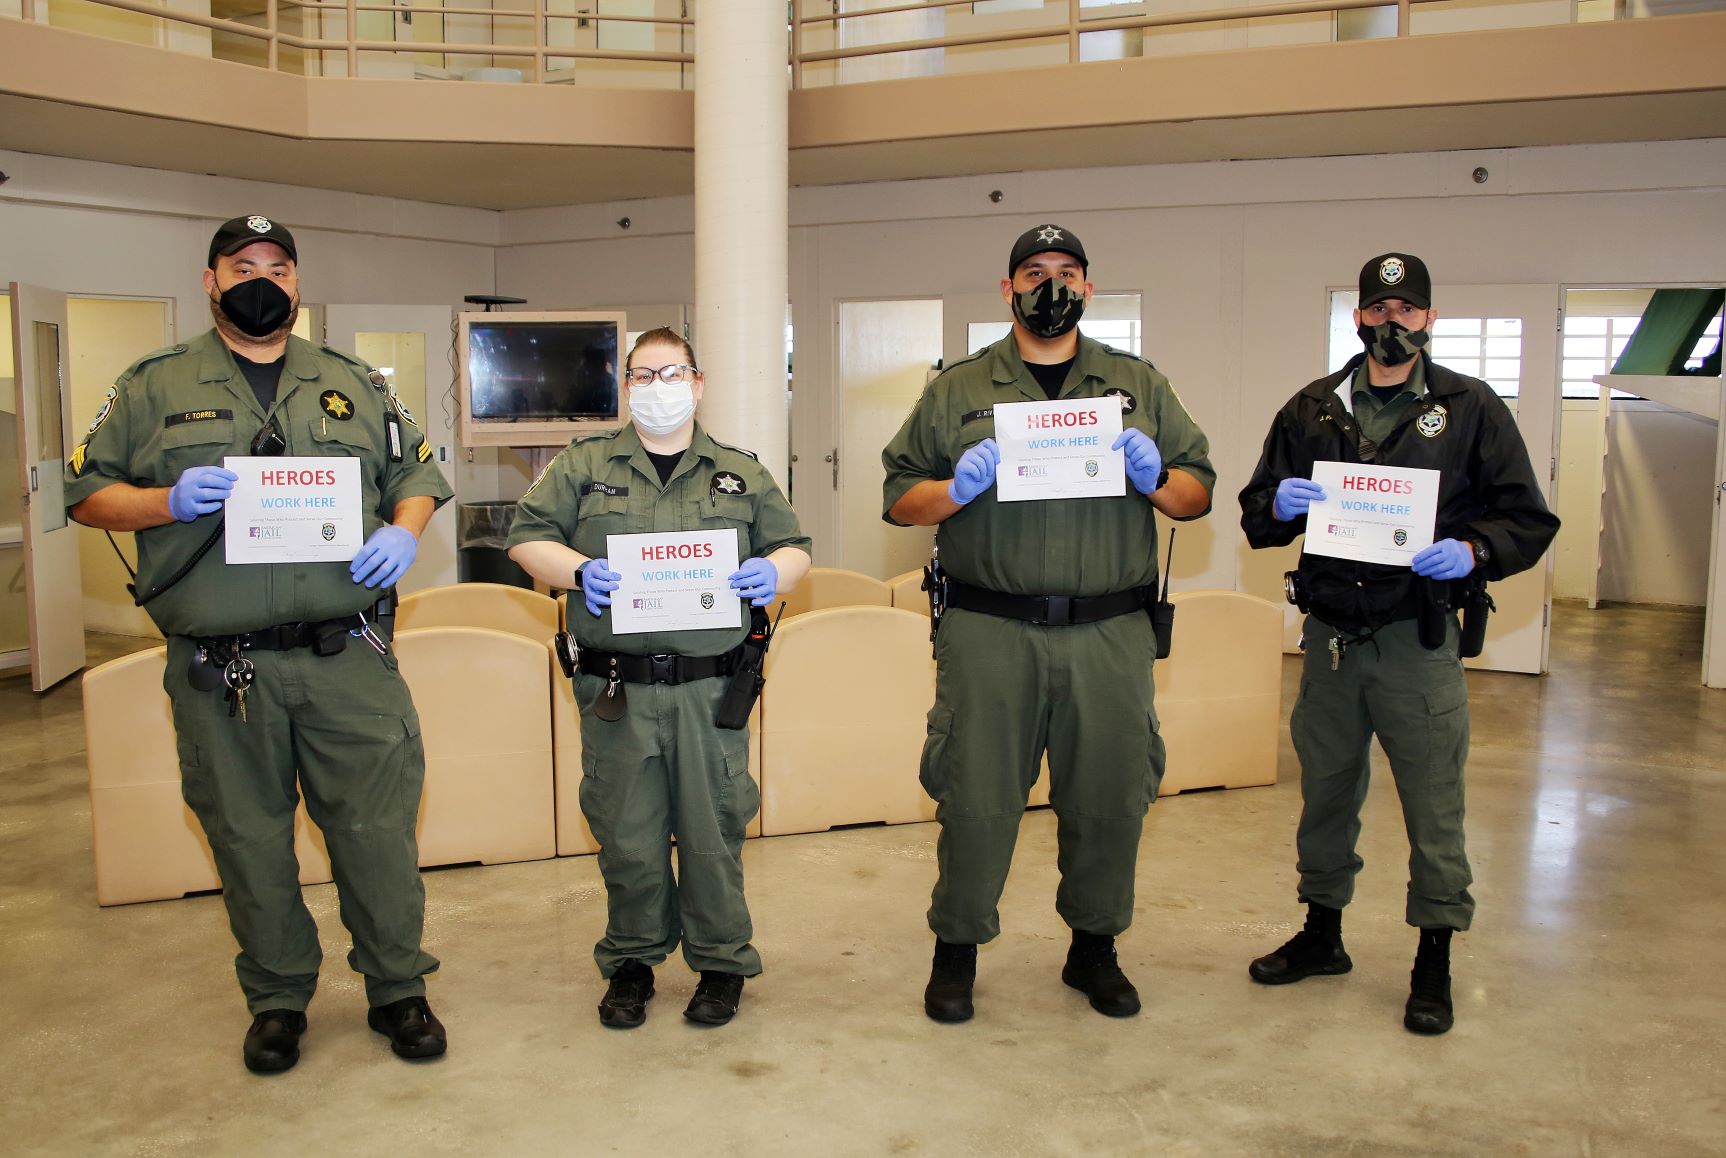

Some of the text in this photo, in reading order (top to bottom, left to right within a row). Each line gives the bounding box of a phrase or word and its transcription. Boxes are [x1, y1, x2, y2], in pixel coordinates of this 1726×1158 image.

[192, 411, 216, 419] TORRES
[1027, 411, 1098, 429] HEROES
[1028, 436, 1099, 449] WORK HERE
[261, 470, 336, 485] HEROES
[1029, 467, 1048, 477] JAIL
[1343, 475, 1413, 495] HEROES
[261, 497, 336, 508] WORK HERE
[1341, 500, 1411, 515] WORK HERE
[261, 528, 281, 538] JAIL
[641, 543, 713, 560] HEROES
[642, 569, 714, 581] WORK HERE
[644, 599, 663, 609] JAIL
